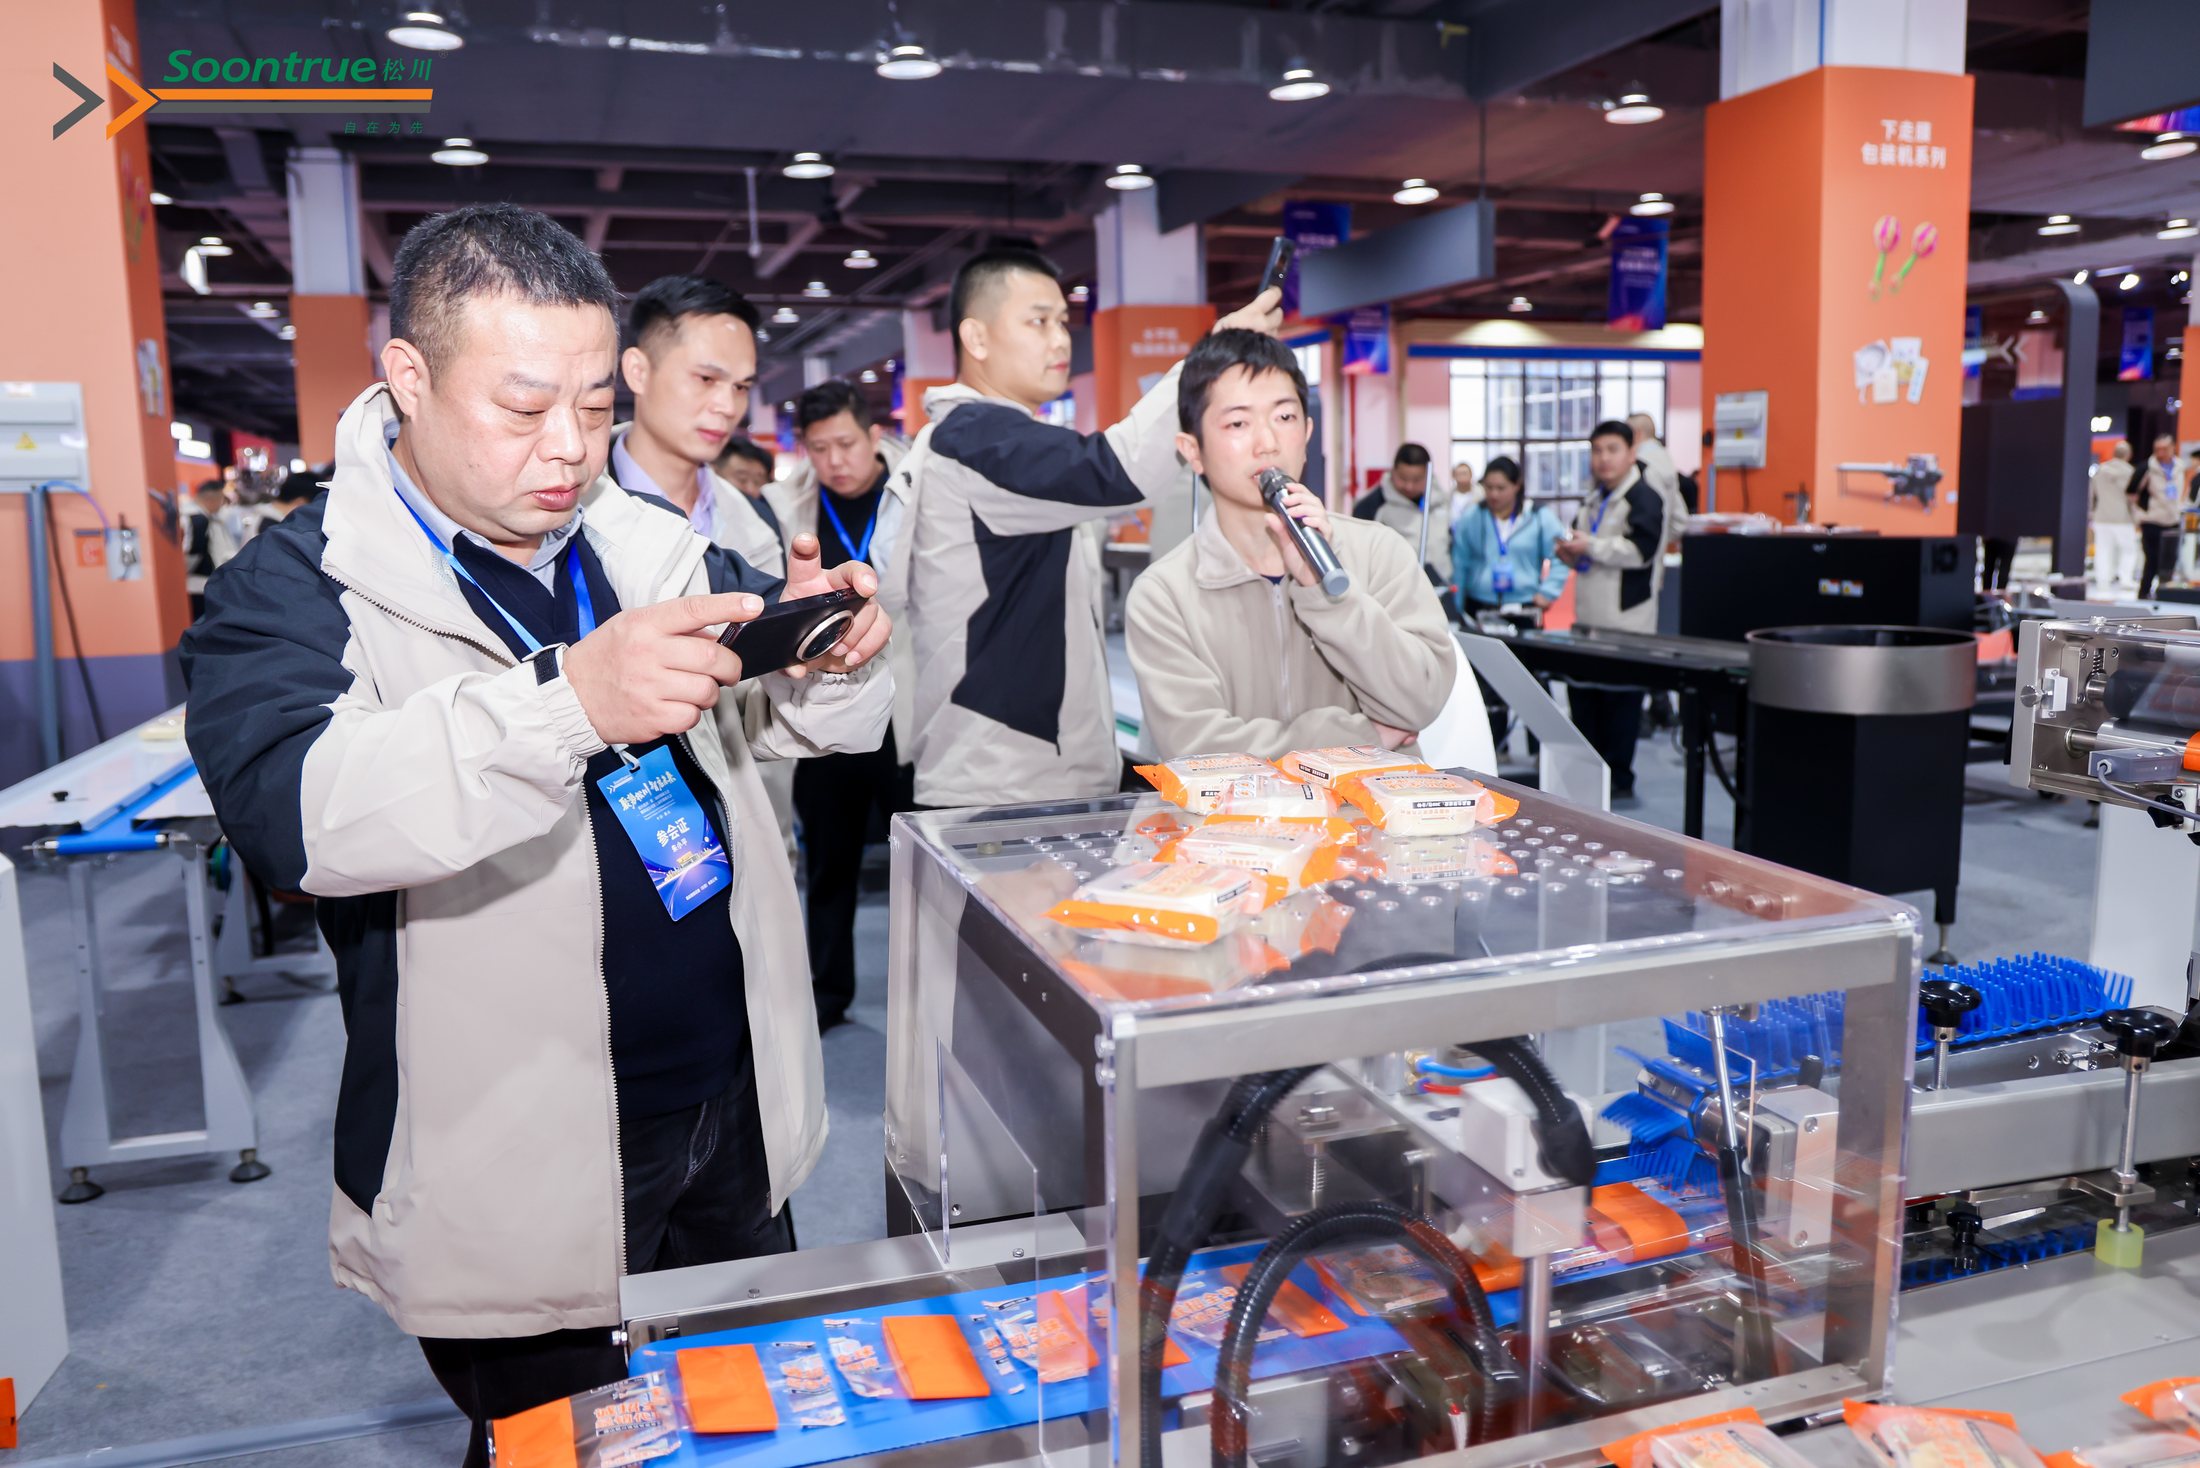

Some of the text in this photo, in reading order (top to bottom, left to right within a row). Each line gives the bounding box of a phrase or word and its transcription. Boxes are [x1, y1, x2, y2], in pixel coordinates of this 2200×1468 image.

[1861, 142, 1946, 168] 包装机系列
[656, 817, 690, 848] 参会证
